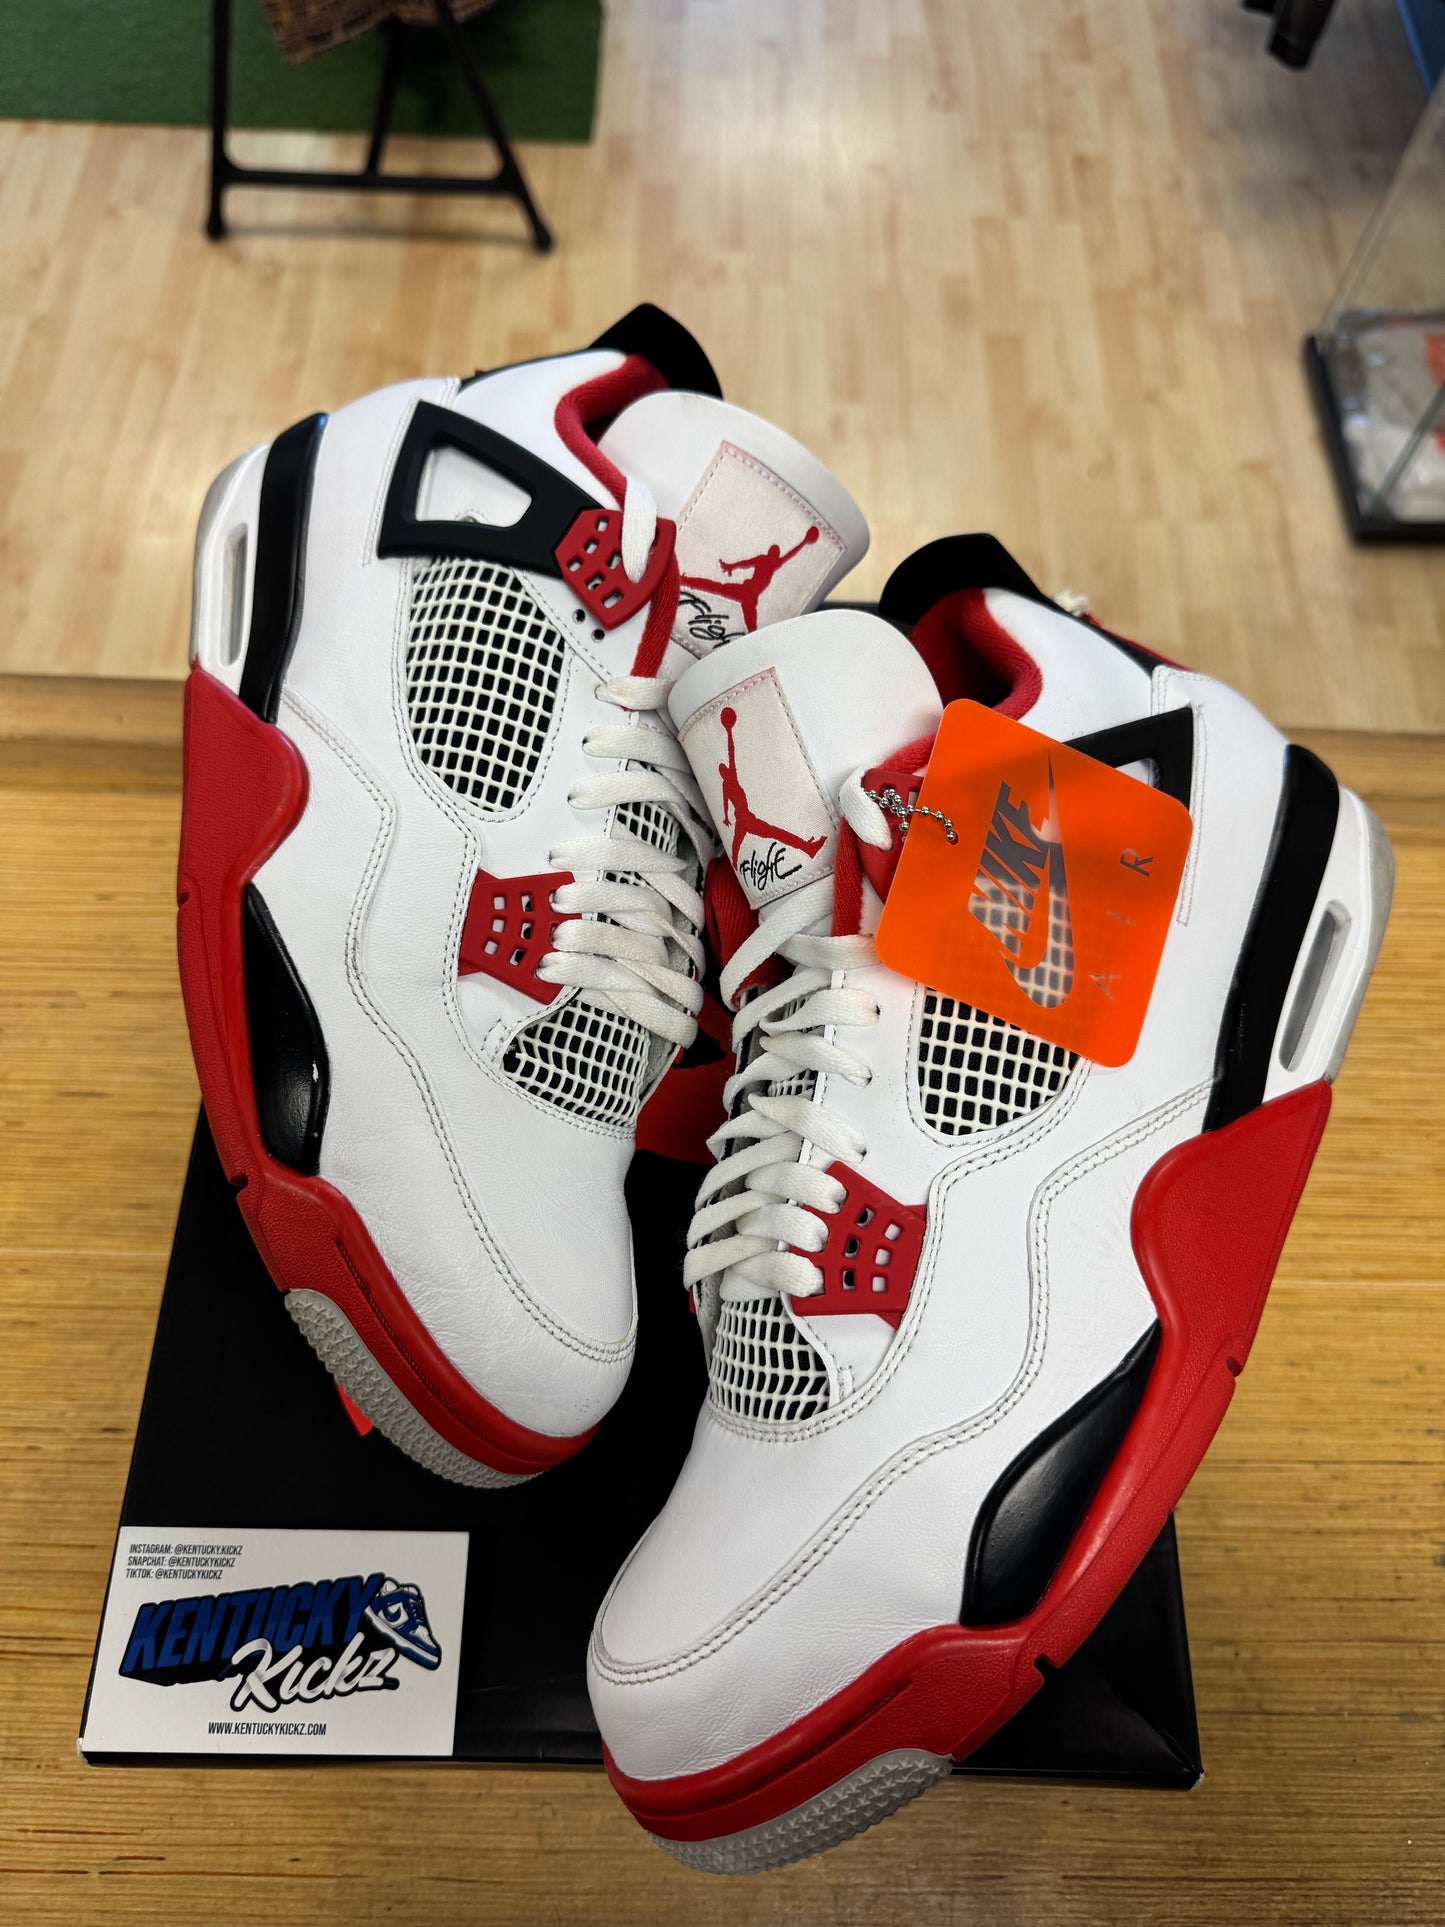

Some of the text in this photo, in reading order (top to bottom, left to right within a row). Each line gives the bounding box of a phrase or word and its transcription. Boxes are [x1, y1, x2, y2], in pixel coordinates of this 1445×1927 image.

[967, 780, 1050, 958] NIKE
[129, 1543, 244, 1556] INSTAGRAM: @KENTUCKY.KICKZ
[127, 1556, 237, 1568] SNAPCHAT: @KENTUCKYKICKZ
[125, 1568, 224, 1580] TIKTOK: @KENTUCKYKICKZ
[120, 1573, 386, 1676] KENTUCKY
[230, 1631, 397, 1711] Kickz
[207, 1721, 327, 1737] WWW.KENTUCKYKICKZ.COM
